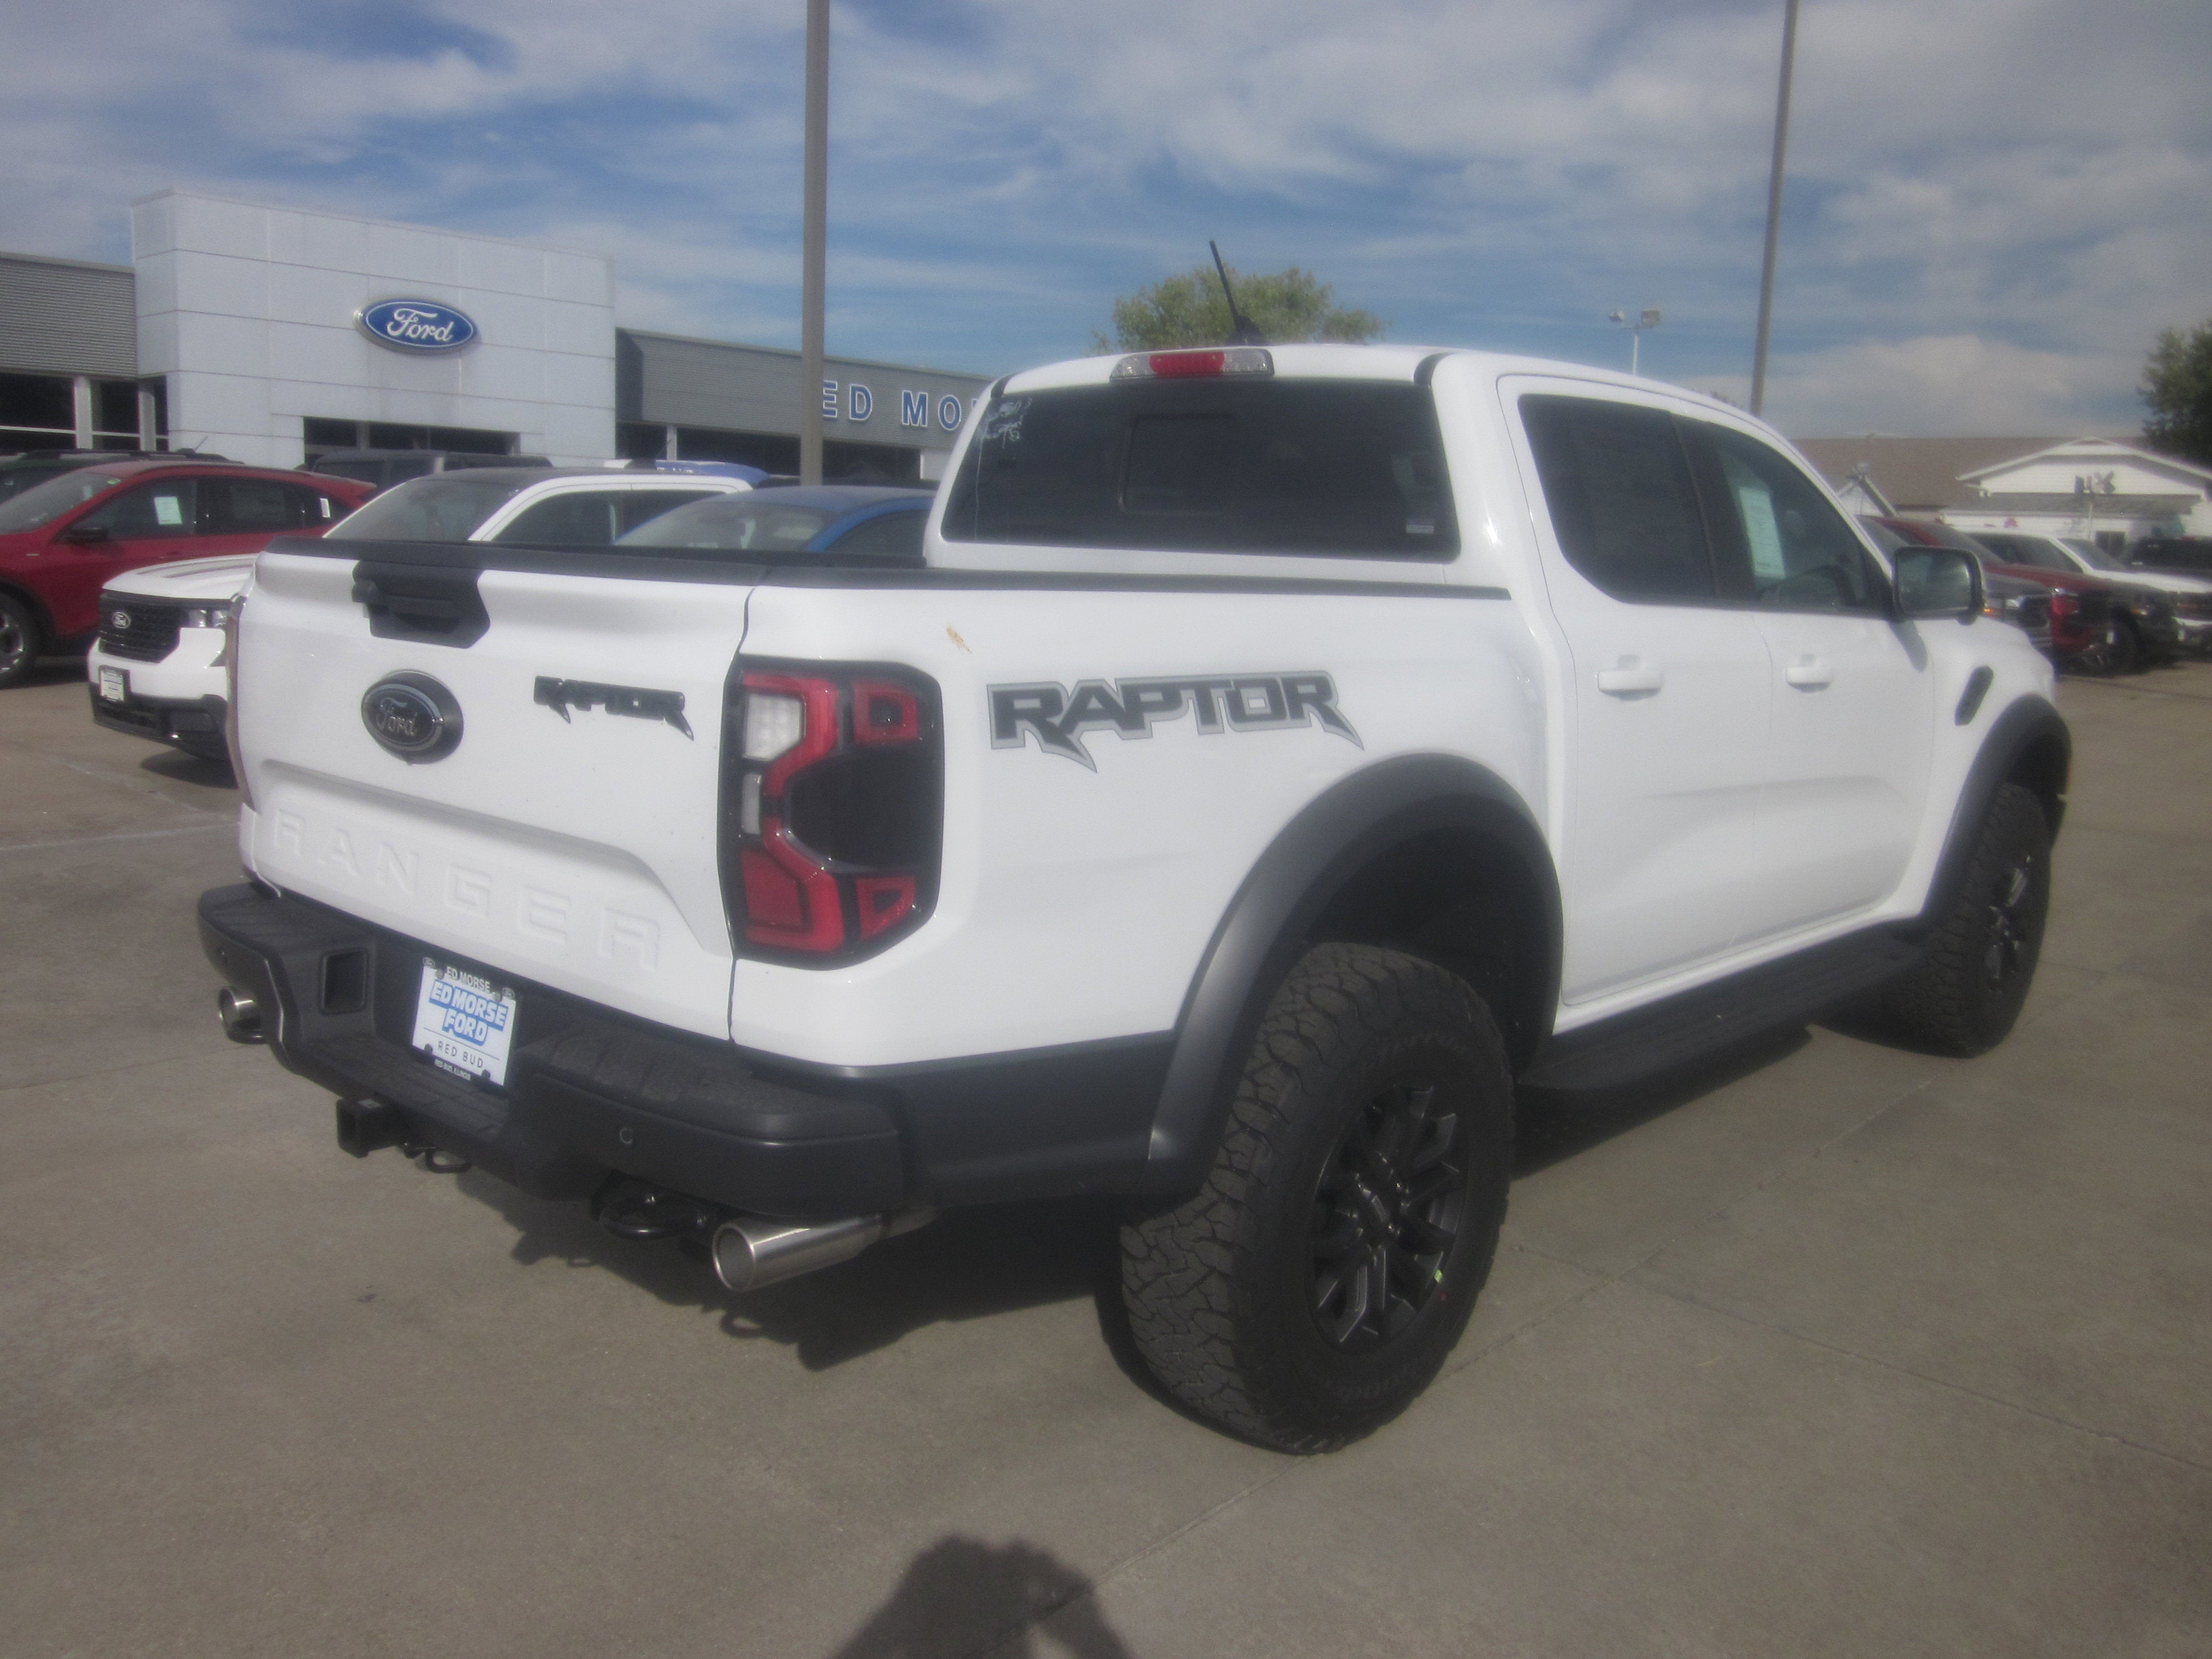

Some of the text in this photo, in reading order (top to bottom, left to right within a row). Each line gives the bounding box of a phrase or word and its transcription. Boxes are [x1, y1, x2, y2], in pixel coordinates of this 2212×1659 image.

[387, 308, 454, 342] Ford
[823, 379, 872, 421] ED
[377, 697, 418, 737] Ford
[986, 669, 1364, 774] RAPTOR
[275, 810, 660, 972] RANGER
[446, 966, 458, 980] ED
[460, 971, 491, 994] MORSE
[431, 981, 507, 1027] ED MORSE
[444, 1008, 487, 1043] FORD
[438, 1041, 483, 1068] RED BUD
